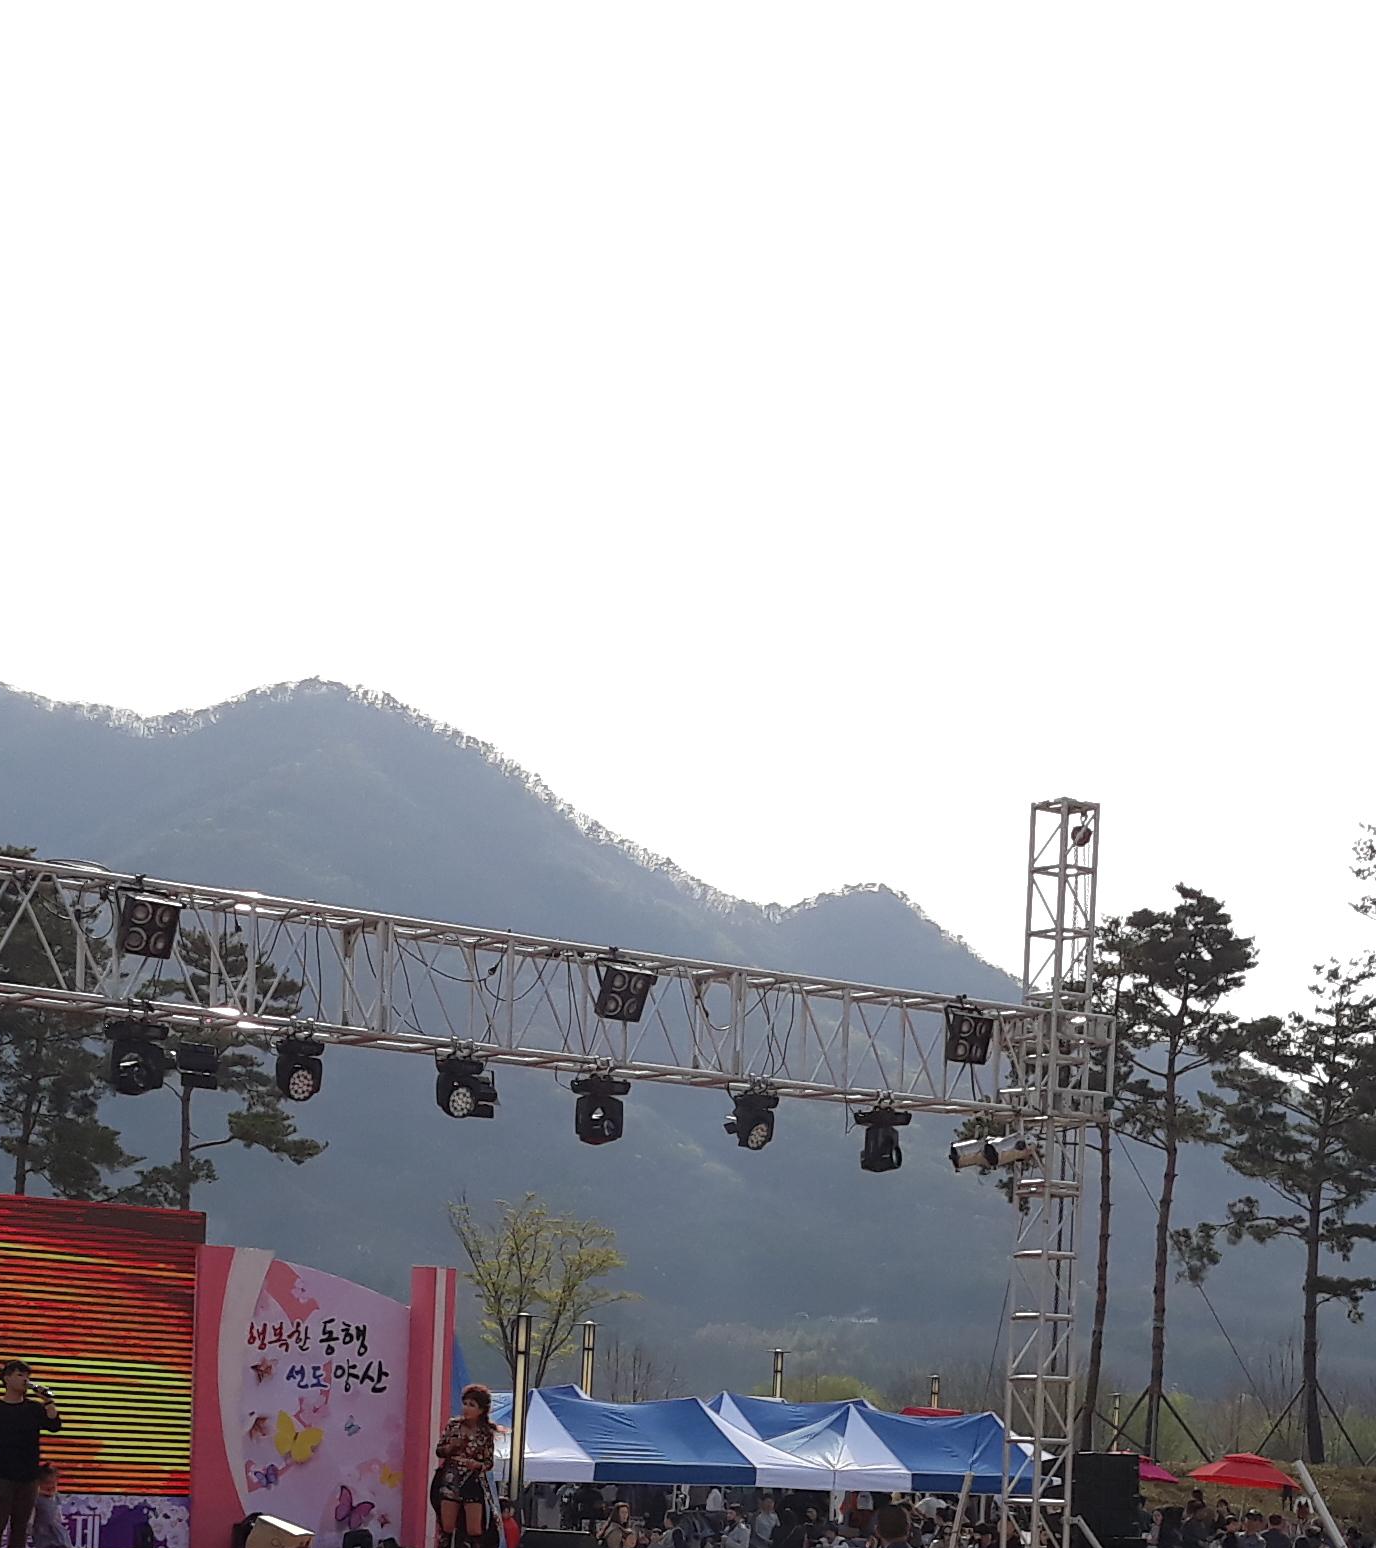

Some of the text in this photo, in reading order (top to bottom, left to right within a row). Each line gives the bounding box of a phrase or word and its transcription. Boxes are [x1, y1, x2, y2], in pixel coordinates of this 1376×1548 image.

[247, 1318, 368, 1356] 행복한 동행
[286, 1359, 389, 1393] 선도 양산
